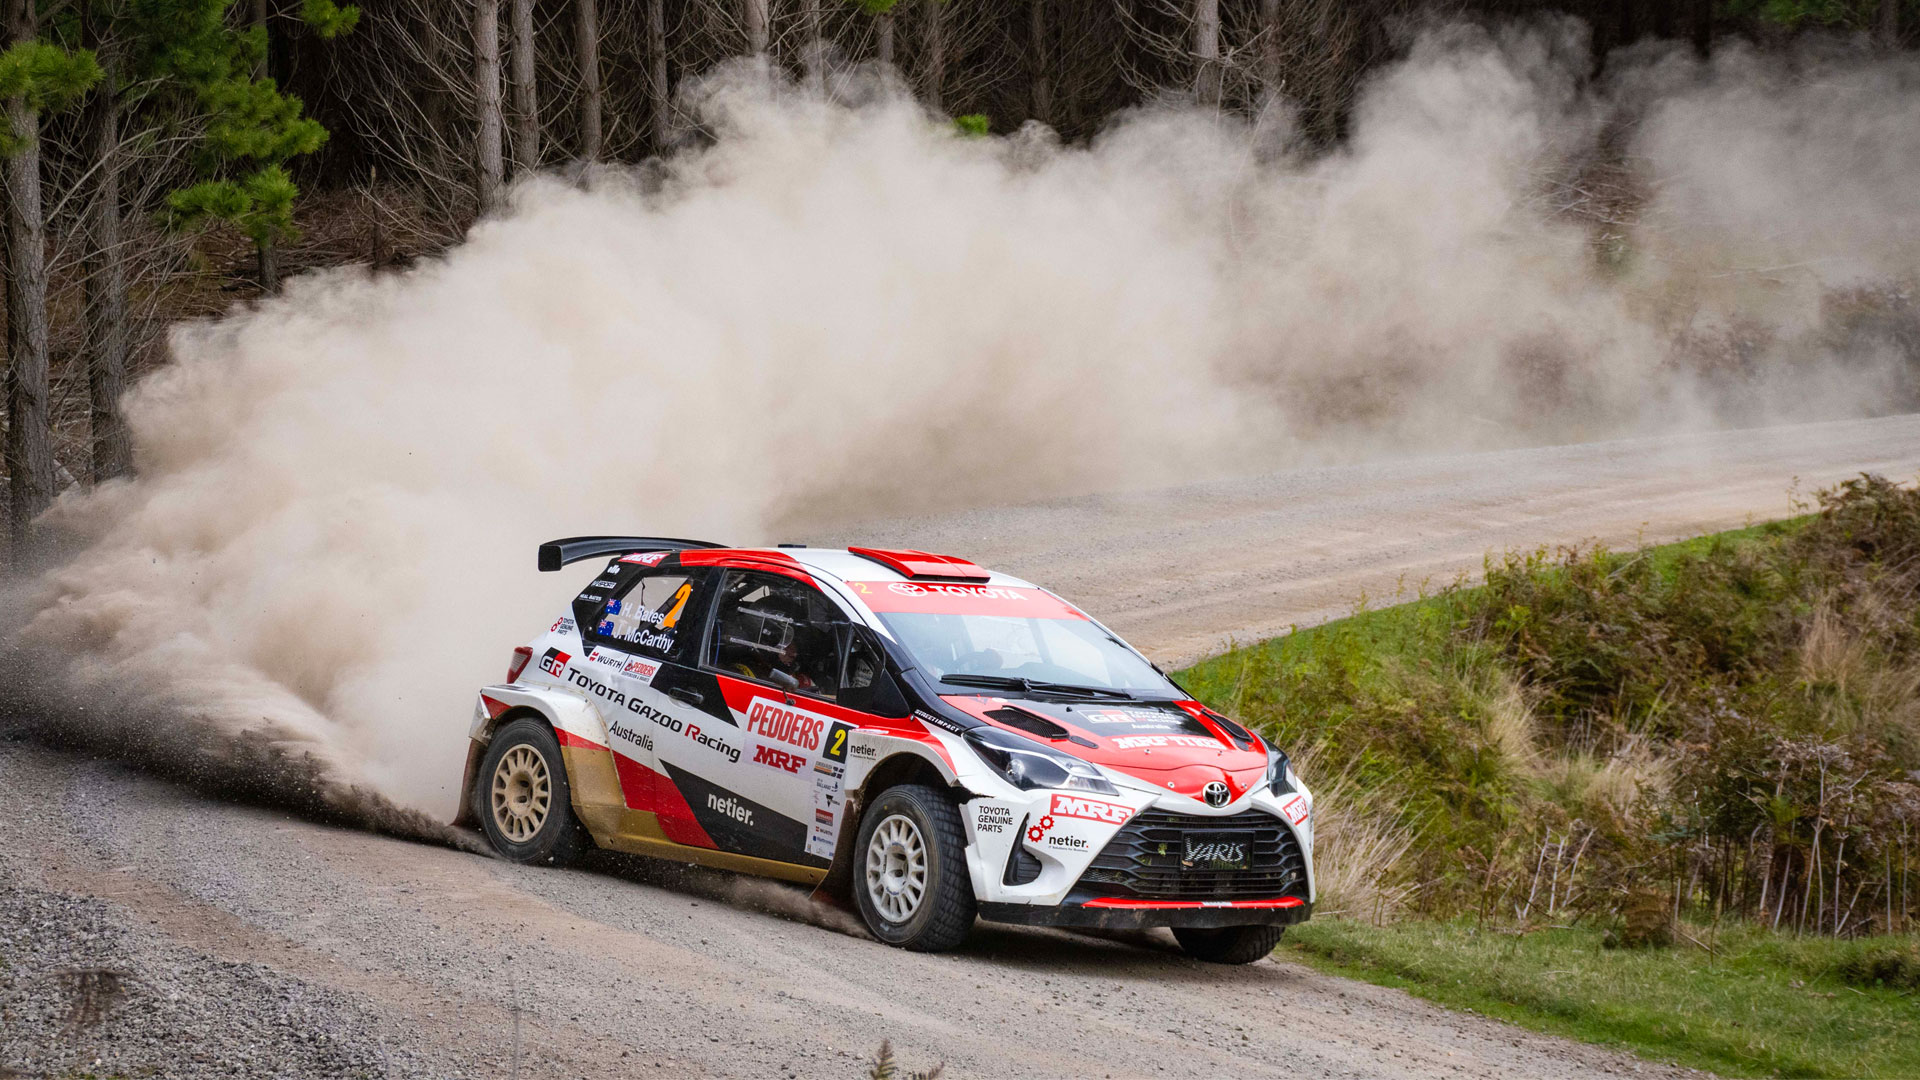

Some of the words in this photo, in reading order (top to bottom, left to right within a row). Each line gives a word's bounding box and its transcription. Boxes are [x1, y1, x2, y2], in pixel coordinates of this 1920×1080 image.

[855, 582, 873, 594] 2
[928, 585, 1028, 600] TOYOTA
[621, 602, 633, 618] H.
[635, 605, 665, 625] Bates
[663, 583, 692, 628] 2
[623, 627, 675, 653] McCarthy
[540, 655, 565, 677] GR
[633, 661, 656, 677] PEDDERS
[567, 667, 625, 705] TOYOTA
[627, 698, 683, 733] GAZOO
[684, 723, 742, 764] Racing
[747, 703, 824, 751] PEDDERS
[609, 720, 654, 751] Australia
[829, 729, 847, 757] 2
[1112, 737, 1168, 749] MRF
[753, 744, 807, 774] MRF
[850, 744, 877, 757] netier.
[707, 793, 754, 826] netier.
[978, 815, 1013, 825] GENUINE
[979, 806, 1011, 816] TOYOTA
[1053, 796, 1133, 823] MRF
[977, 824, 1003, 833] PARTS
[1048, 835, 1089, 849] netier.
[1184, 837, 1246, 862] YARIS
